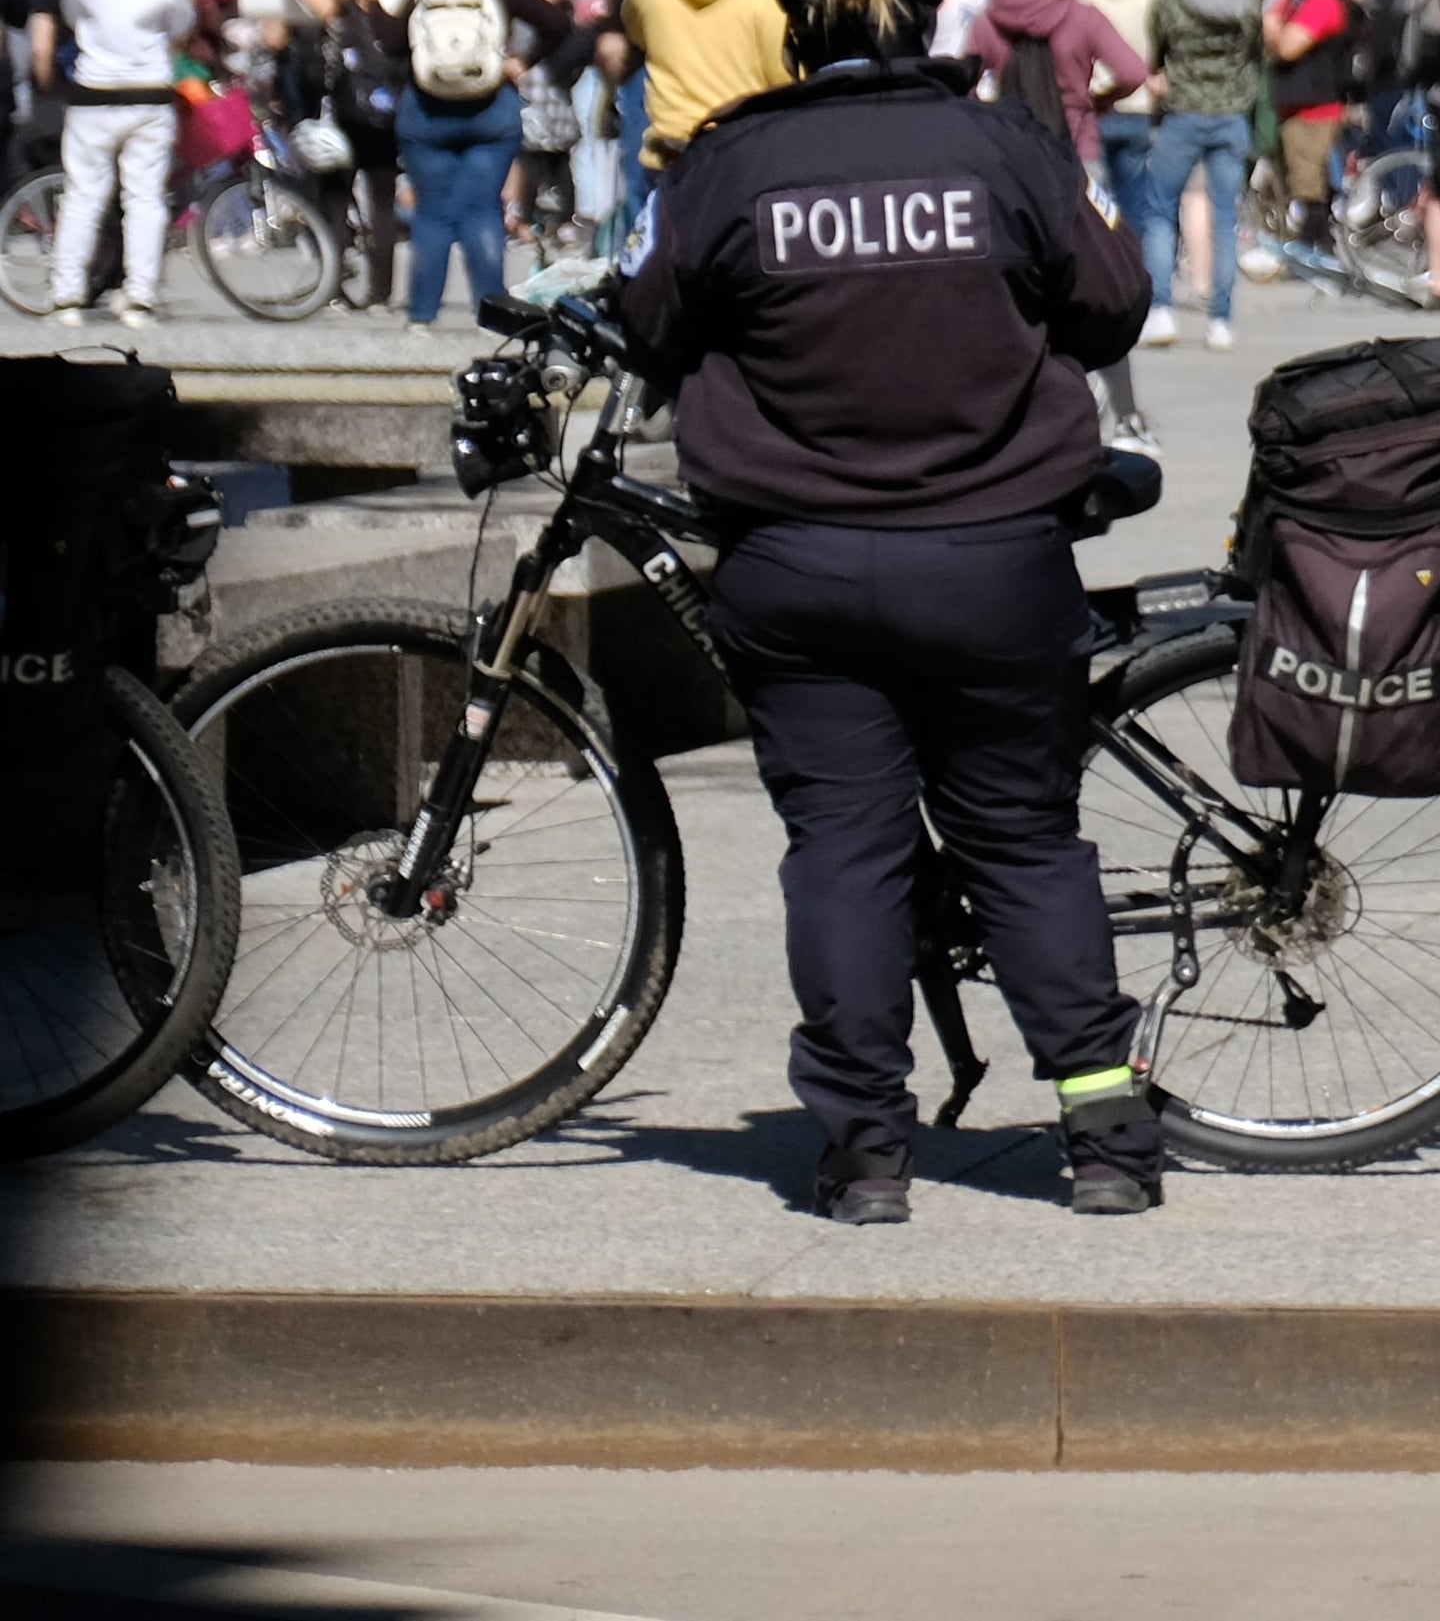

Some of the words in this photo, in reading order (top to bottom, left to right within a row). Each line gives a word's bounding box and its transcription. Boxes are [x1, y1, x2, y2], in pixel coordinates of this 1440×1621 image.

[770, 189, 975, 263] POLICE
[643, 551, 725, 672] CHIC
[1268, 646, 1434, 707] POLICE
